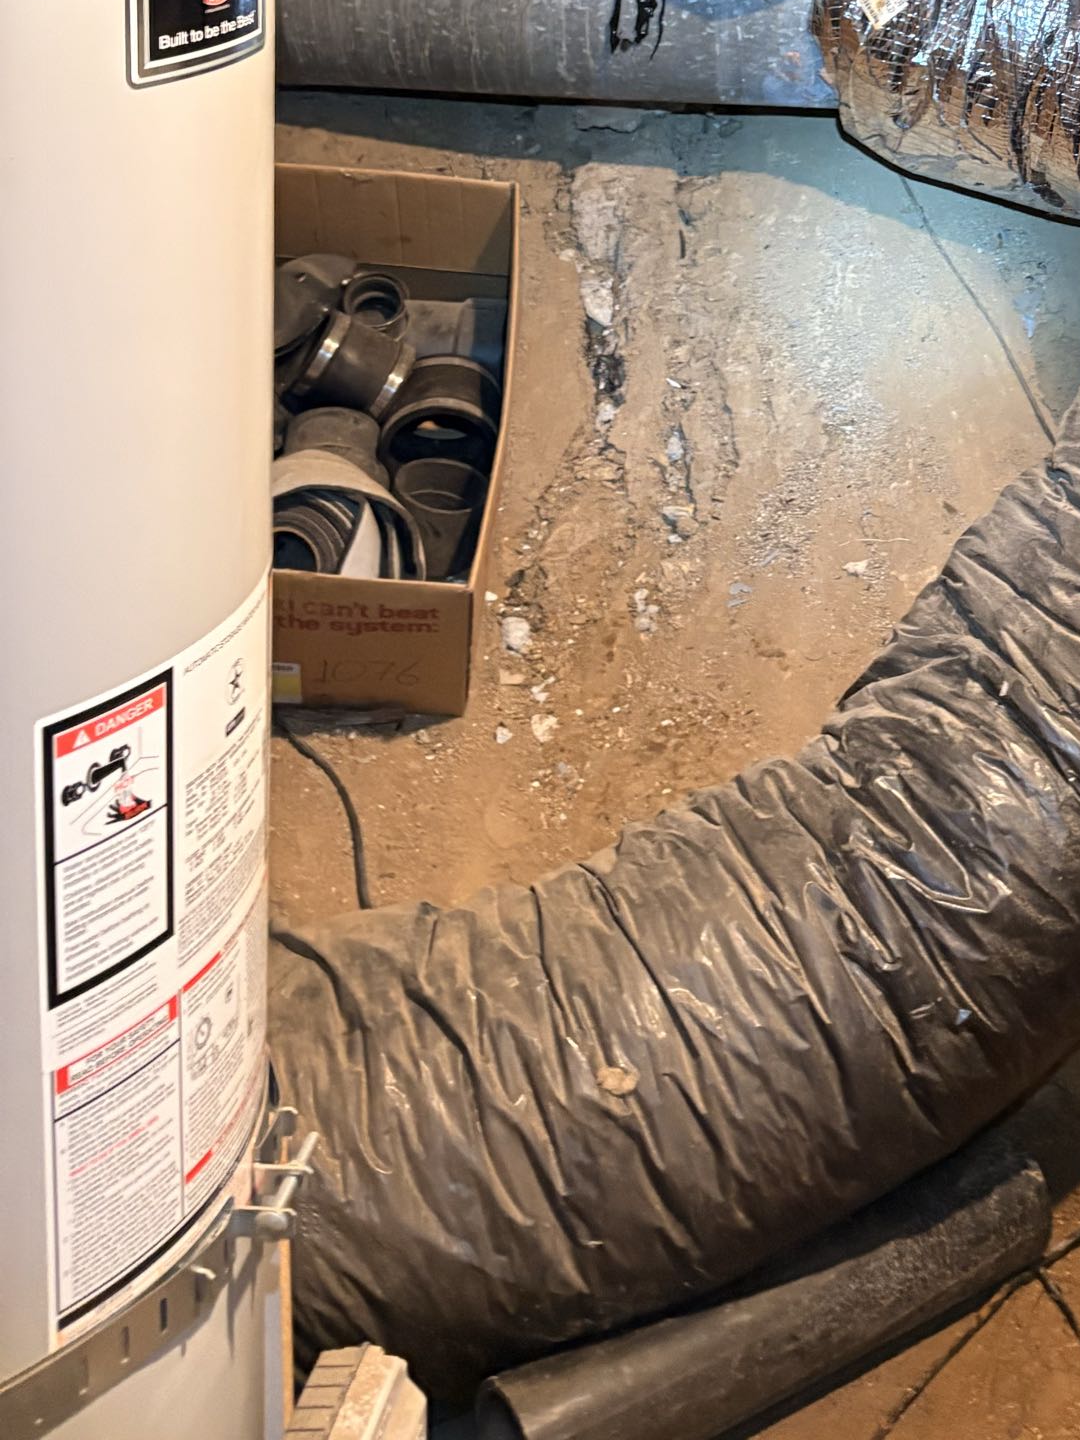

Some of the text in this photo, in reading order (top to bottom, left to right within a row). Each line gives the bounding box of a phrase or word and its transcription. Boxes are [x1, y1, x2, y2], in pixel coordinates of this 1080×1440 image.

[158, 32, 189, 50] Built
[189, 29, 204, 43] to
[204, 25, 220, 39] be
[219, 20, 237, 34] the
[274, 613, 321, 631] the
[378, 604, 440, 620] beat
[95, 698, 153, 737] DANGER
